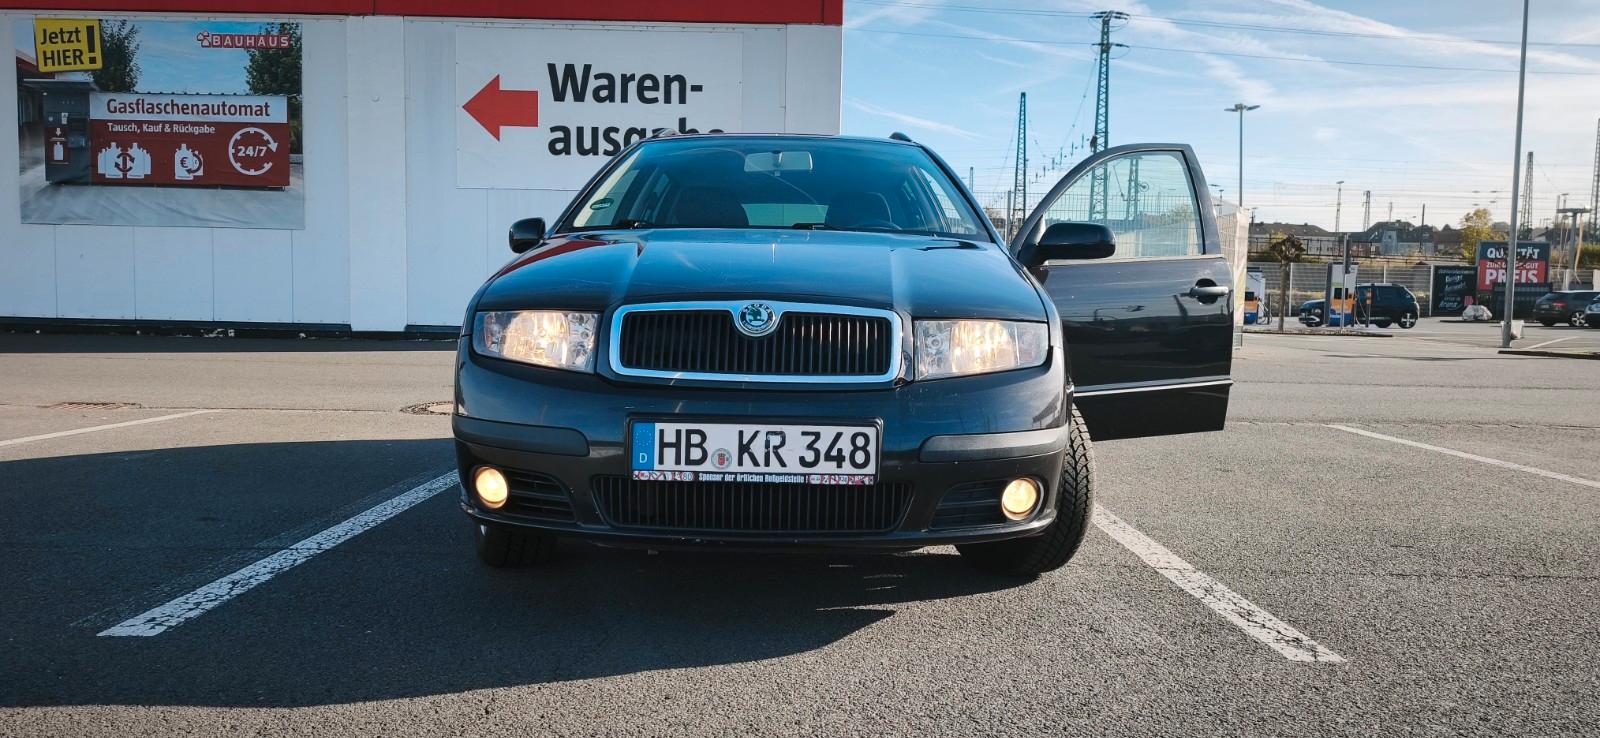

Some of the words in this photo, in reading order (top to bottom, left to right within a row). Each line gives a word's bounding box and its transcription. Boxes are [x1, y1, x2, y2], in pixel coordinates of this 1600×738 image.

[40, 26, 81, 46] Jetzt
[86, 25, 97, 65] !
[211, 34, 290, 48] BAUHAUS
[42, 48, 85, 67] HIER
[546, 62, 704, 105] Waren-
[106, 98, 271, 117] Gasflaschenautomat
[107, 122, 140, 134] Tausch,
[142, 123, 163, 133] Kauf
[164, 123, 172, 133] &
[172, 122, 216, 135] Rückgabe
[237, 145, 267, 158] 24/7
[639, 452, 648, 464] D
[658, 428, 709, 466] HB
[737, 429, 787, 468] KR
[798, 430, 871, 469] 348
